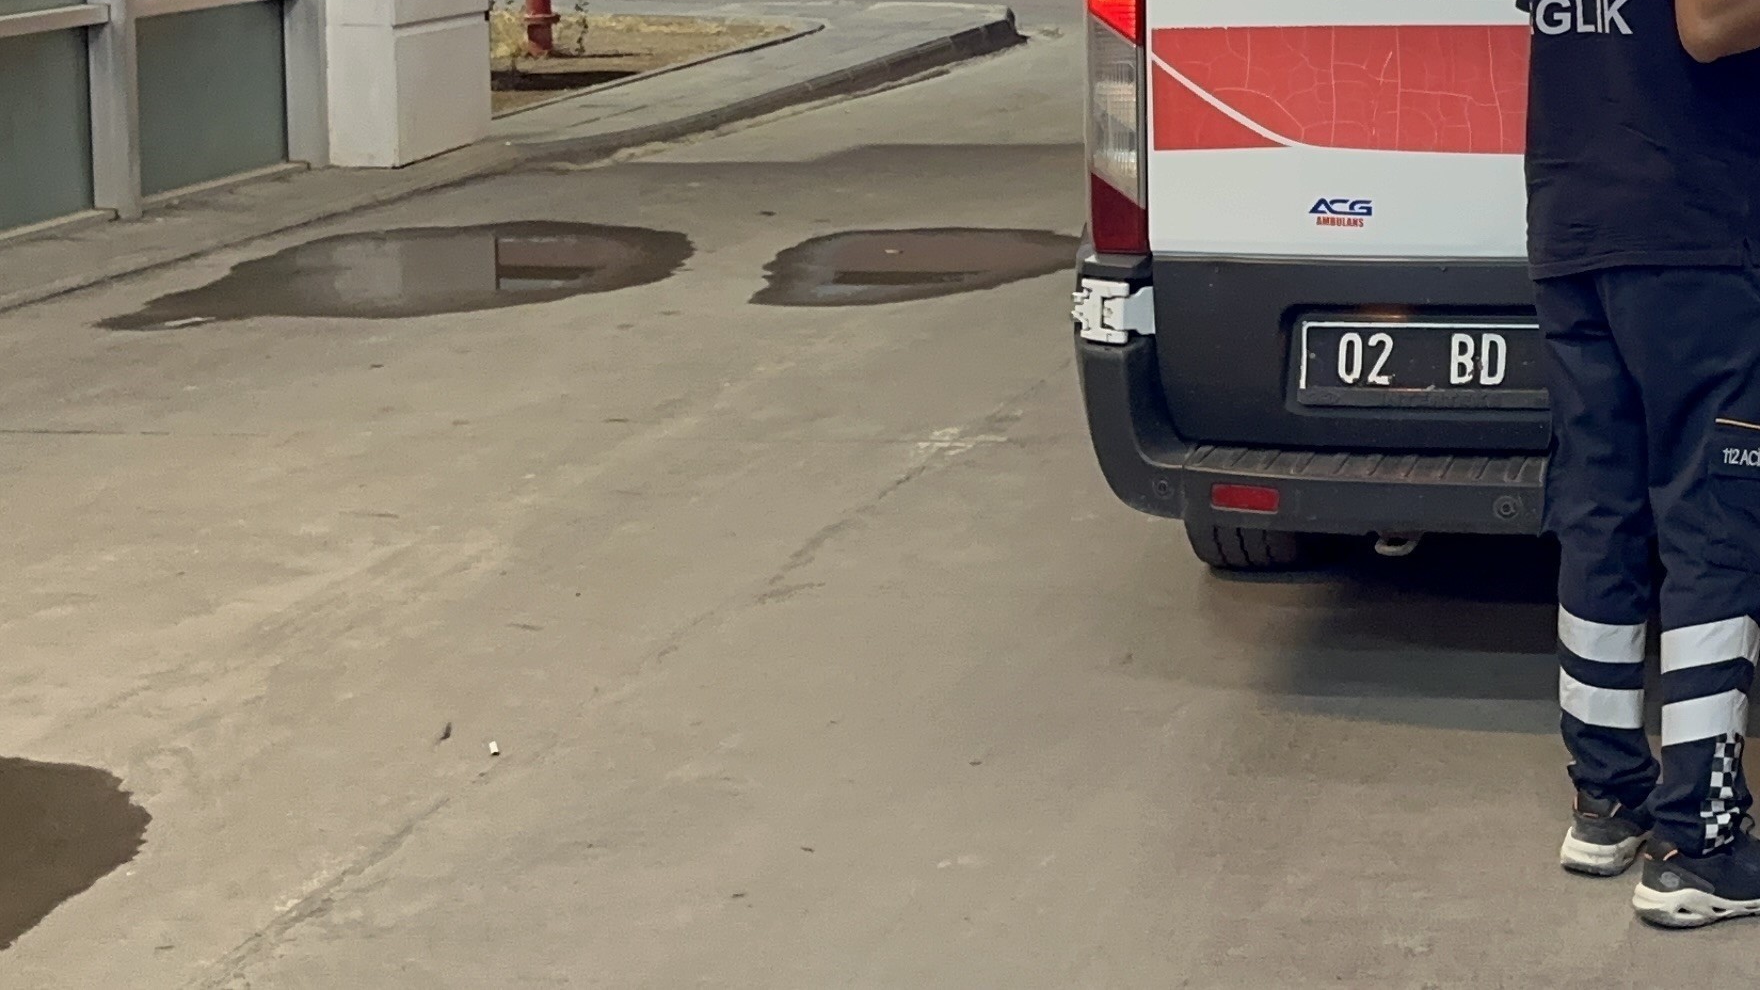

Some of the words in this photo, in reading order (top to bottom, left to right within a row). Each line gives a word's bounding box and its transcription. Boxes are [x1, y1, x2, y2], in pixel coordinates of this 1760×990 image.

[1309, 198, 1372, 216] ACG
[1316, 216, 1364, 227] AMBULANS
[1337, 332, 1394, 386] 02
[1450, 333, 1507, 385] BD
